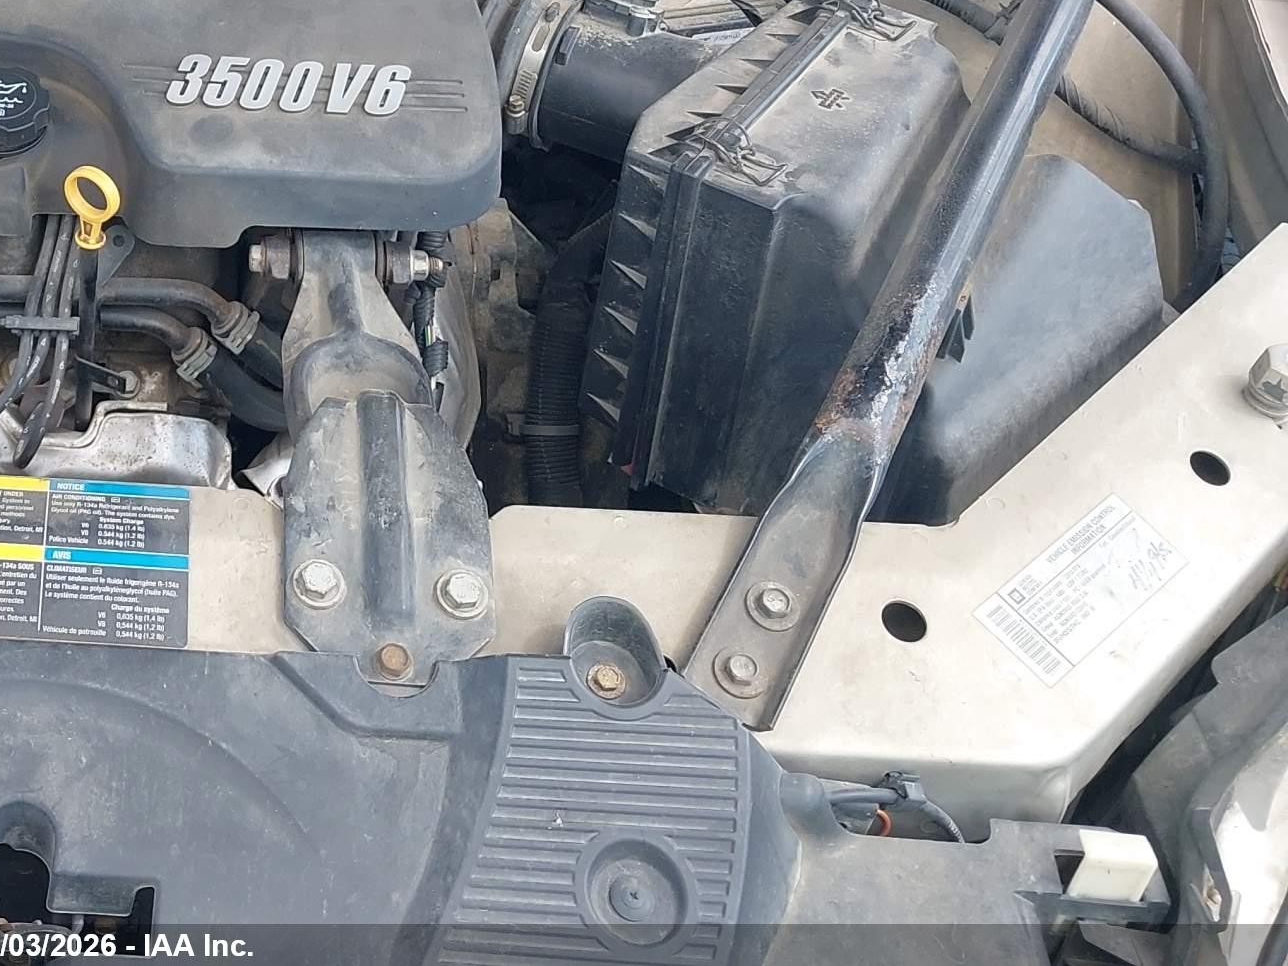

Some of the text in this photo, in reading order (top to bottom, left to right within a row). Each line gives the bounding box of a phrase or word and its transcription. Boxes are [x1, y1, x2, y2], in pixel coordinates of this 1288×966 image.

[165, 53, 413, 117] 3500 V6
[56, 482, 84, 490] NOTICE
[68, 536, 88, 544] Vehicle
[52, 550, 71, 559] AVIS
[17, 562, 34, 570] SOUS
[46, 564, 86, 573] CLIMATISEUR
[45, 573, 67, 581] Utiliser
[67, 575, 98, 583] seulement
[106, 577, 123, 585] fluide
[79, 593, 103, 601] contient
[111, 604, 132, 612] Charge
[78, 628, 106, 636] patrouille
